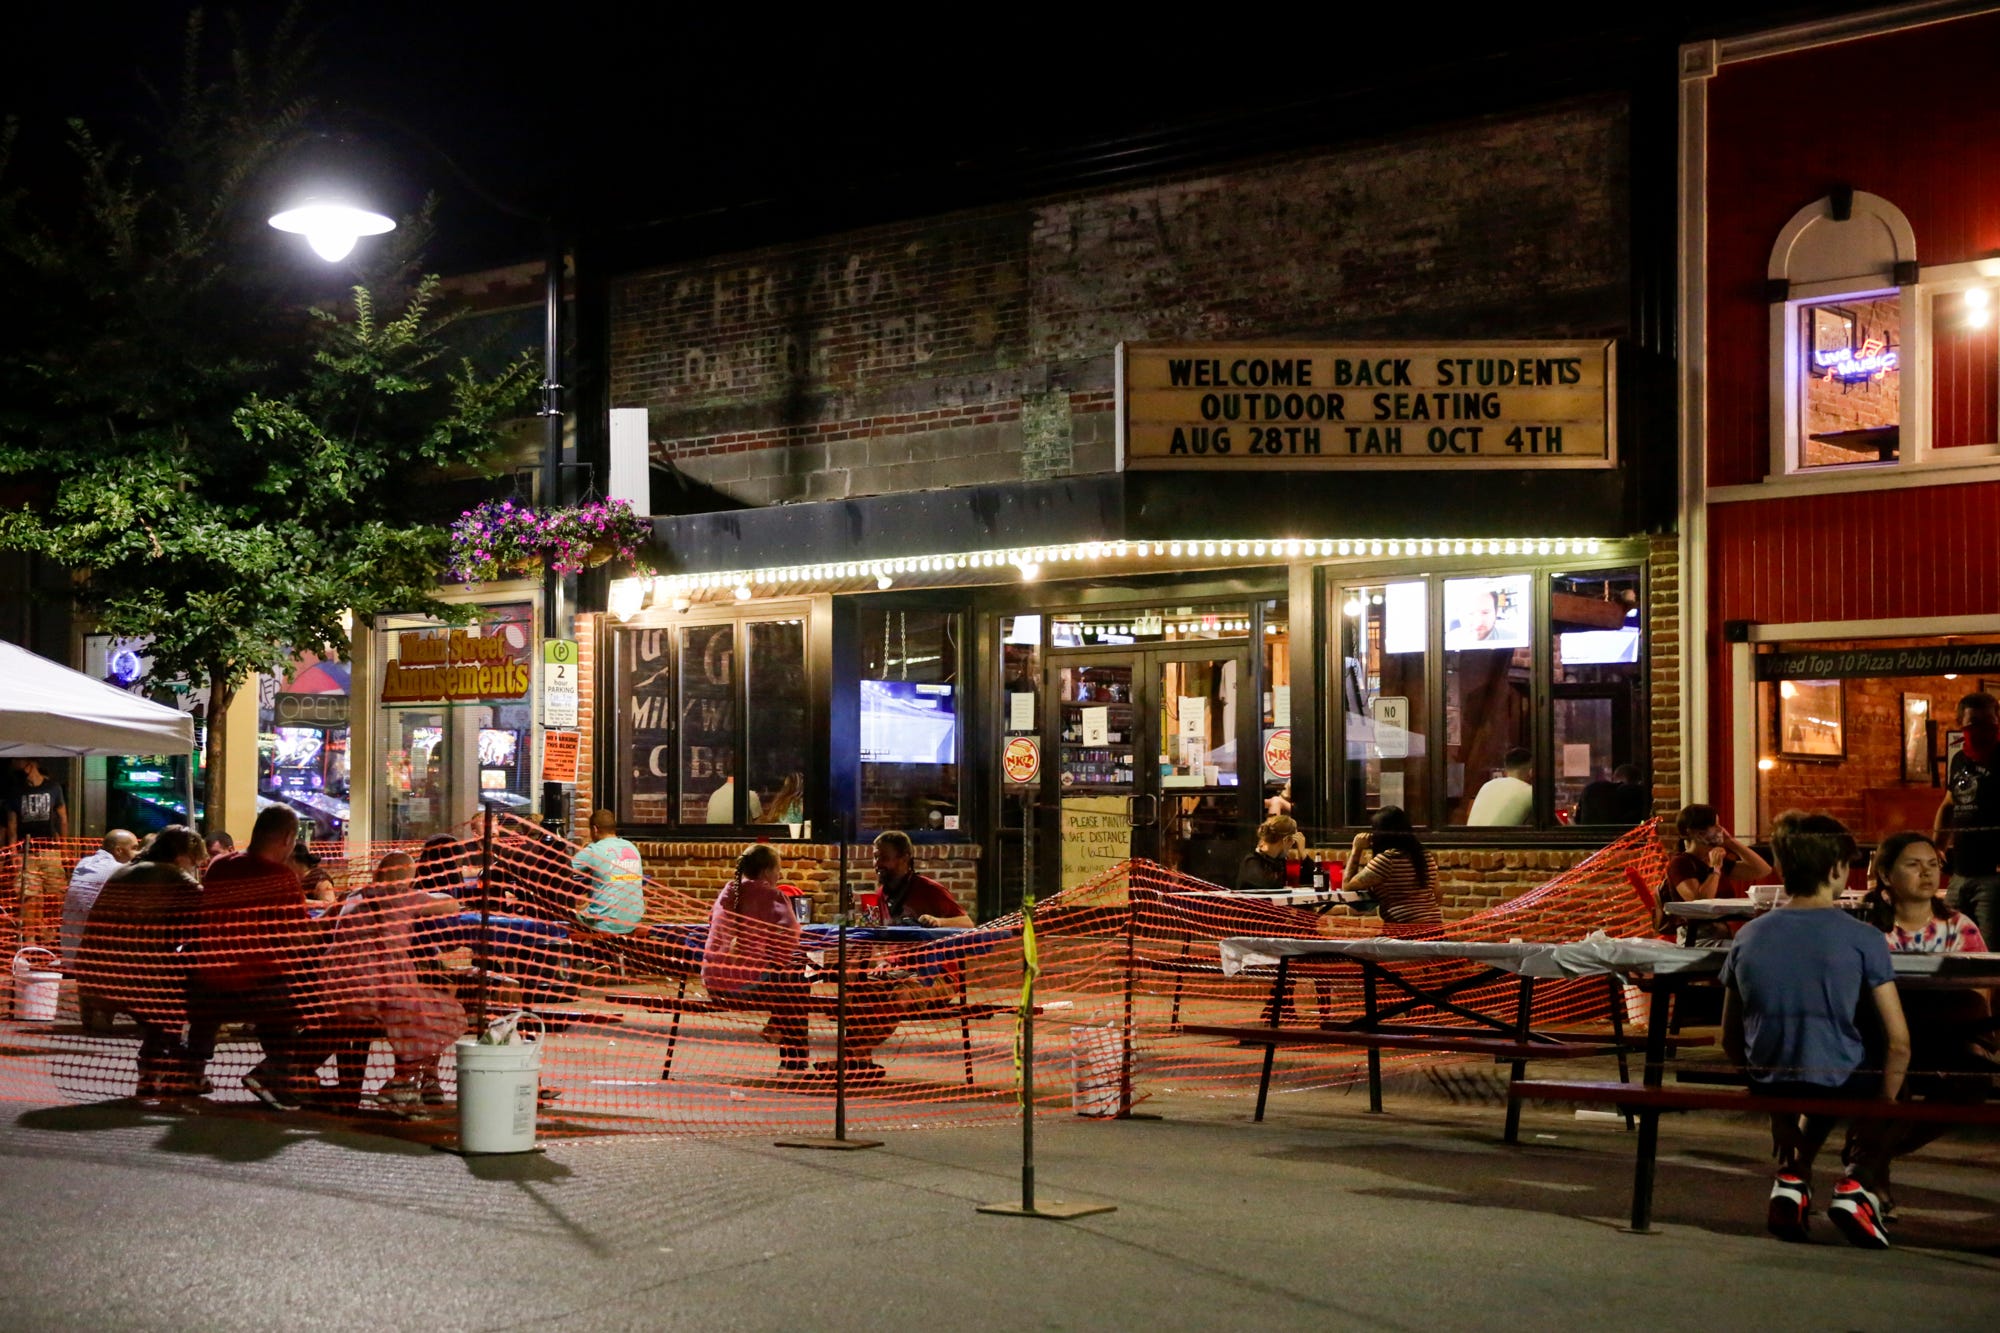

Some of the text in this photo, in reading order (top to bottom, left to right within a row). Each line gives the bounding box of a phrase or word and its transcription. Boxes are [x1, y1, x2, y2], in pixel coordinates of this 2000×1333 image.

[1168, 357, 1582, 387] WELCOME BACK STUDENTS
[1201, 392, 1501, 420] OUTDOOR SEATING
[1169, 426, 1563, 455] AUG 28TH TAH OCT 4TH
[399, 629, 506, 665] Main Street
[557, 665, 565, 678] 2
[1767, 655, 1808, 674] Voted
[1808, 655, 1834, 677] Top
[1838, 654, 1854, 671] 10
[1857, 653, 1894, 671] Pizza
[1897, 651, 1933, 670] Pubs
[381, 655, 529, 702] Amusements
[547, 686, 575, 694] PARKING
[280, 695, 347, 720] OPEN
[1384, 706, 1396, 718] NO
[1070, 815, 1129, 828] PLEASE MAINT
[1069, 832, 1086, 843] SAFE
[1089, 831, 1129, 844] DISTANCE
